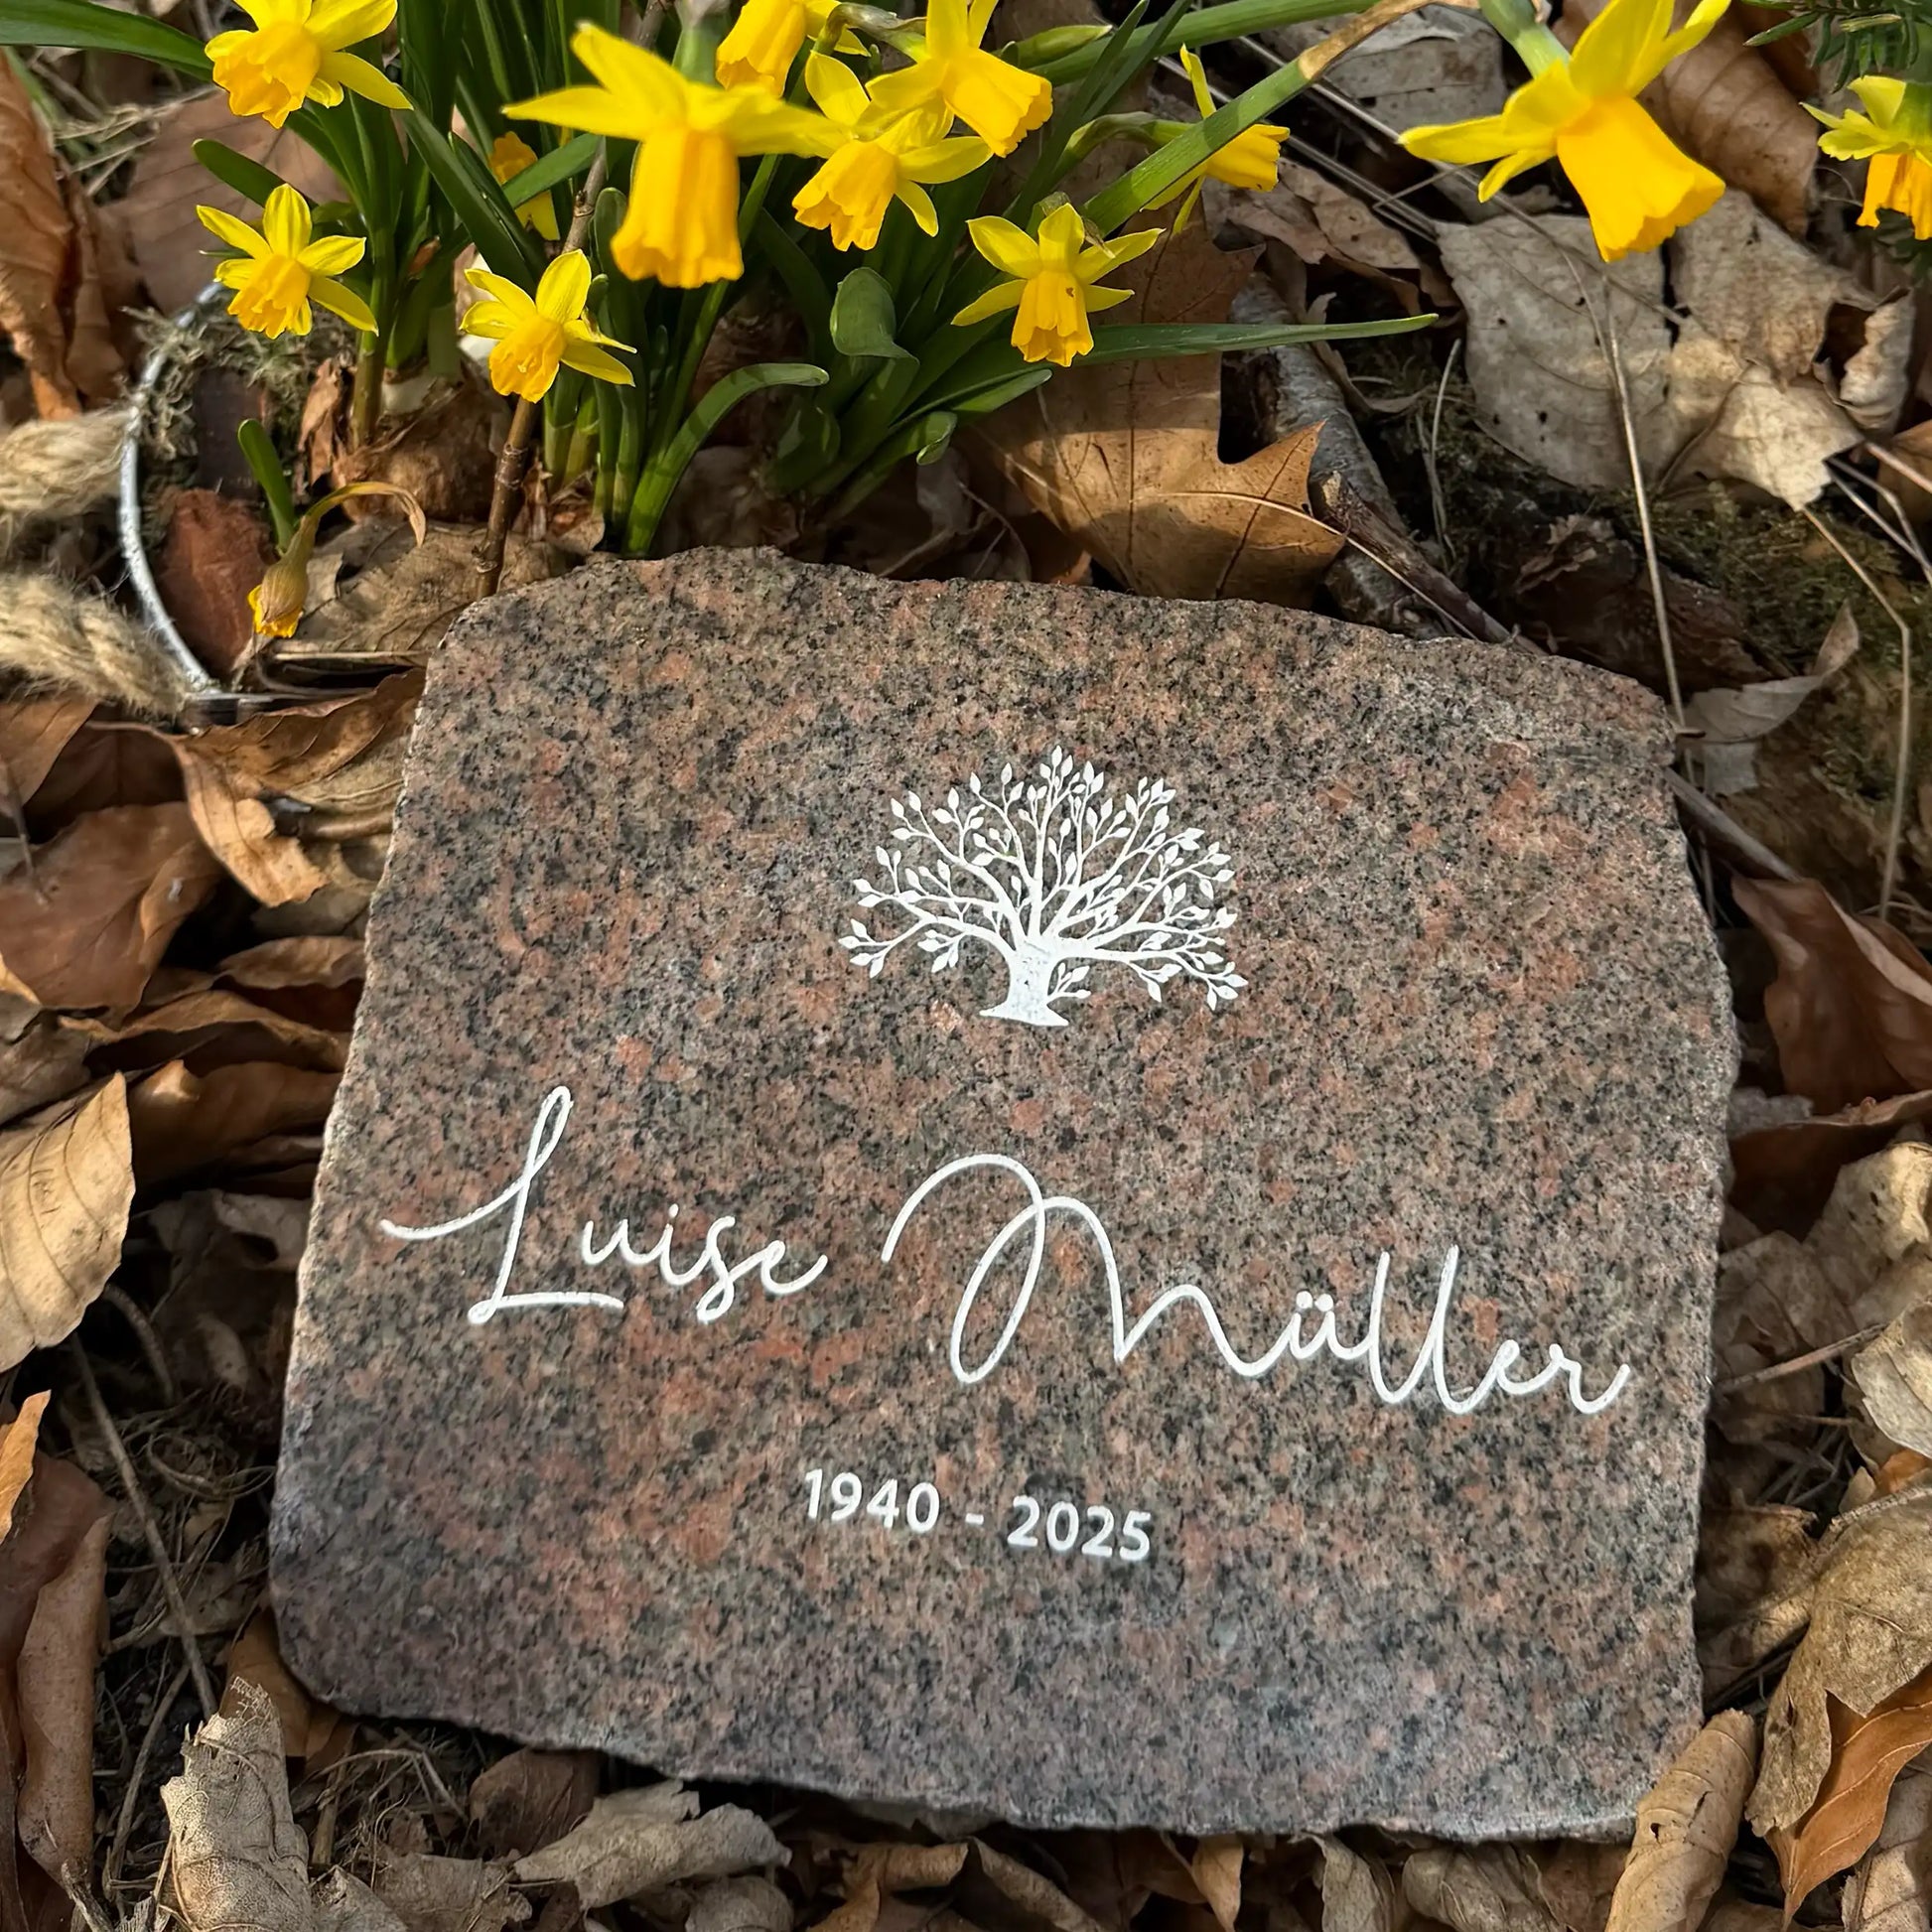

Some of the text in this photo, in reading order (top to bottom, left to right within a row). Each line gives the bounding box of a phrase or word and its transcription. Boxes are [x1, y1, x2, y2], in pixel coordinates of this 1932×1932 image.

[379, 1085, 1631, 1415] Luise Müller
[804, 1468, 1152, 1562] 1940 - 2025
